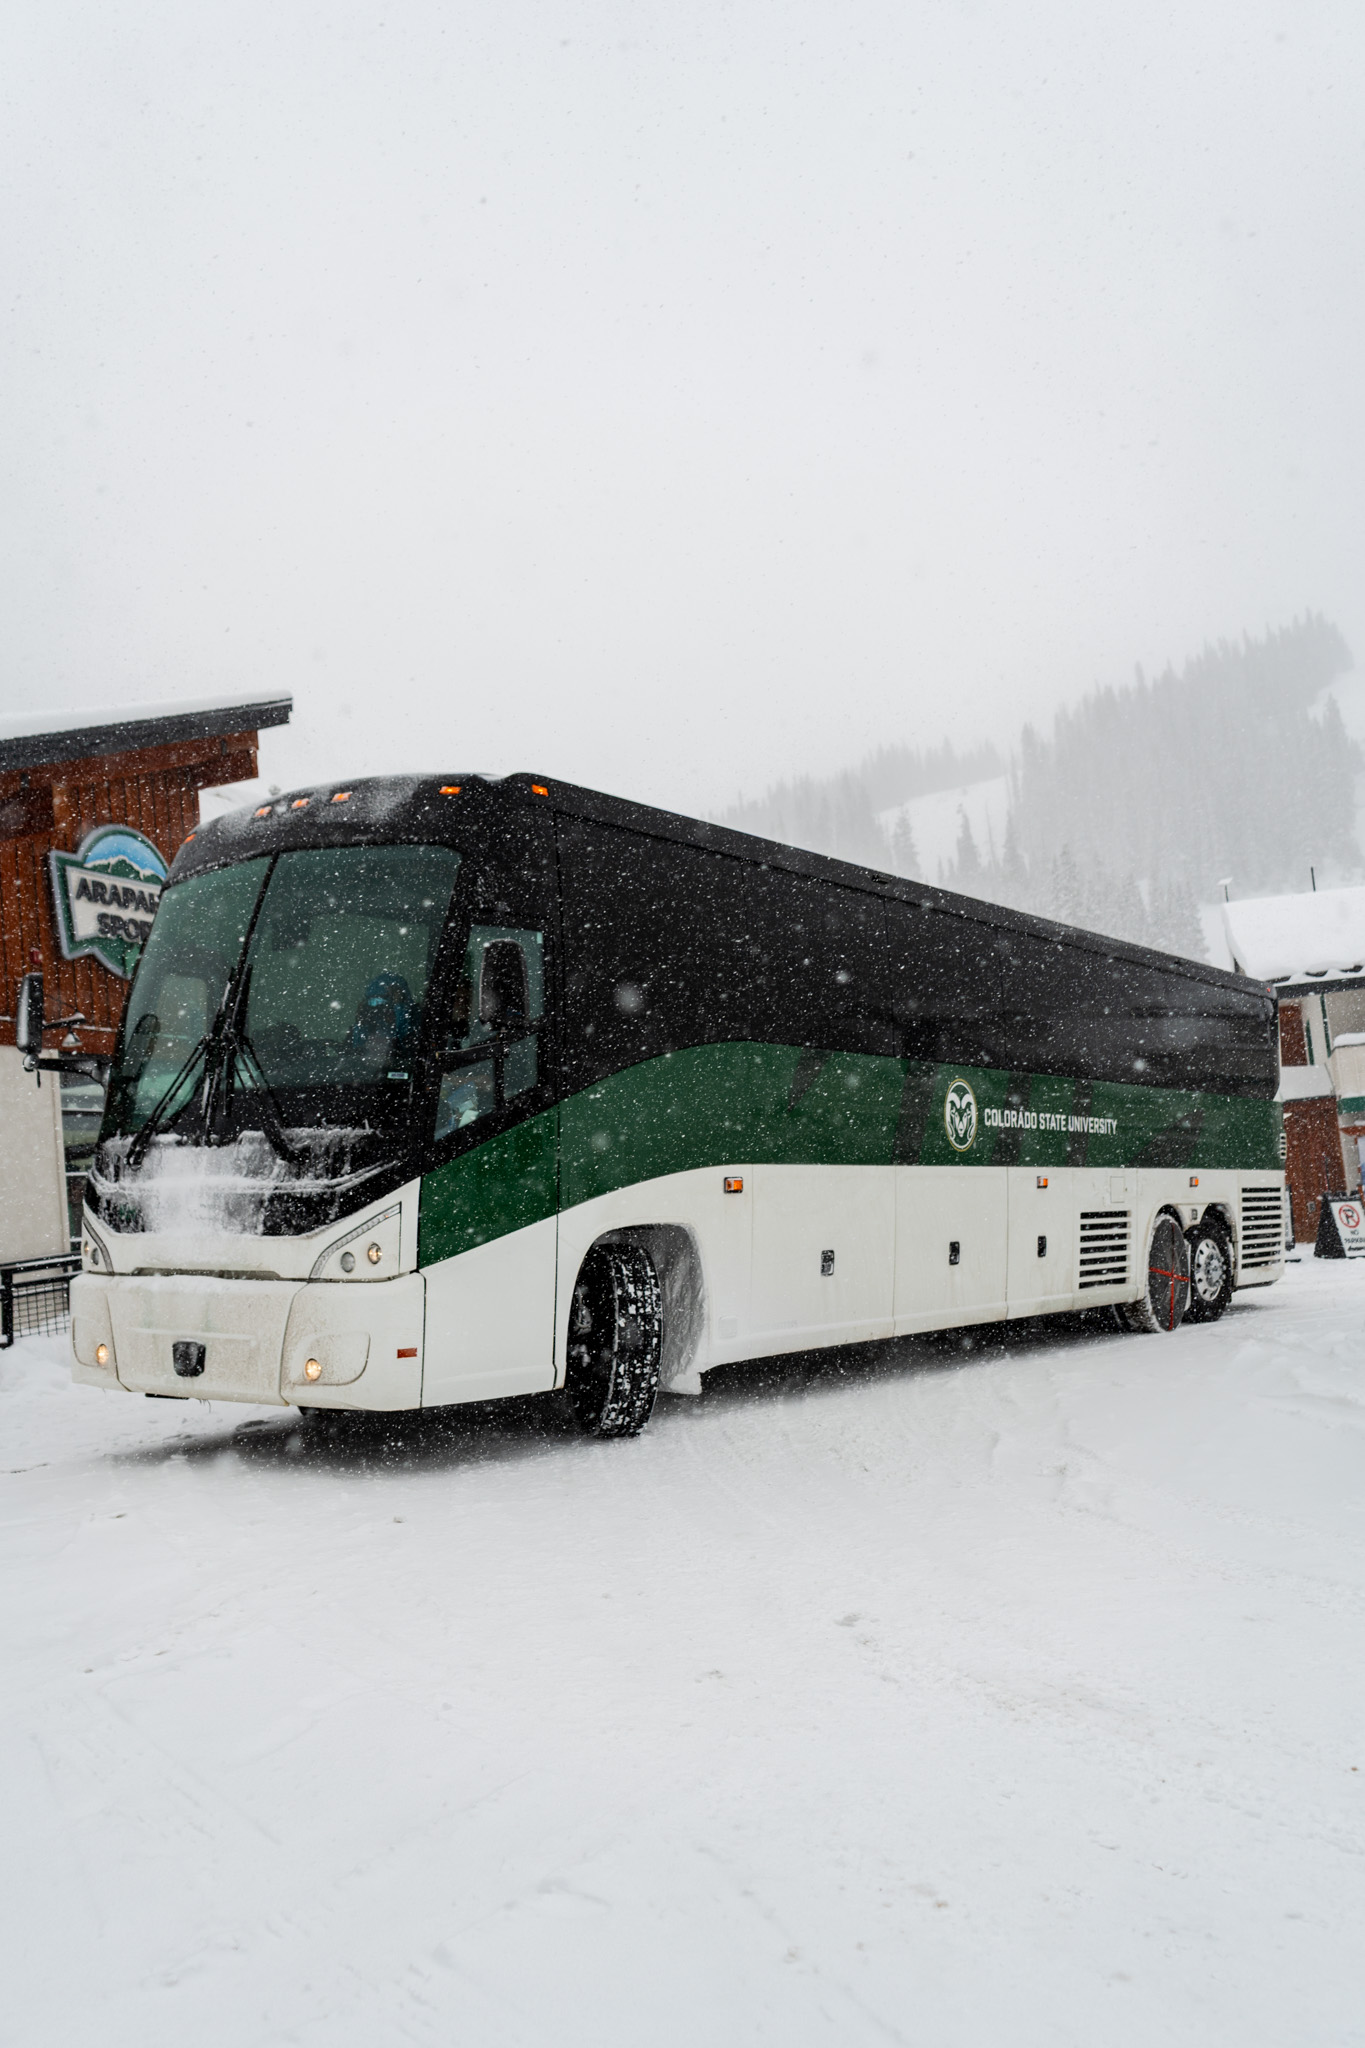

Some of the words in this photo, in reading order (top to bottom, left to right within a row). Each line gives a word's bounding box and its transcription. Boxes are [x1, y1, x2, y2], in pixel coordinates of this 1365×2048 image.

[984, 1108, 1037, 1129] COLORADO
[1039, 1113, 1066, 1131] STATE
[1068, 1115, 1117, 1134] UNIVERSITY
